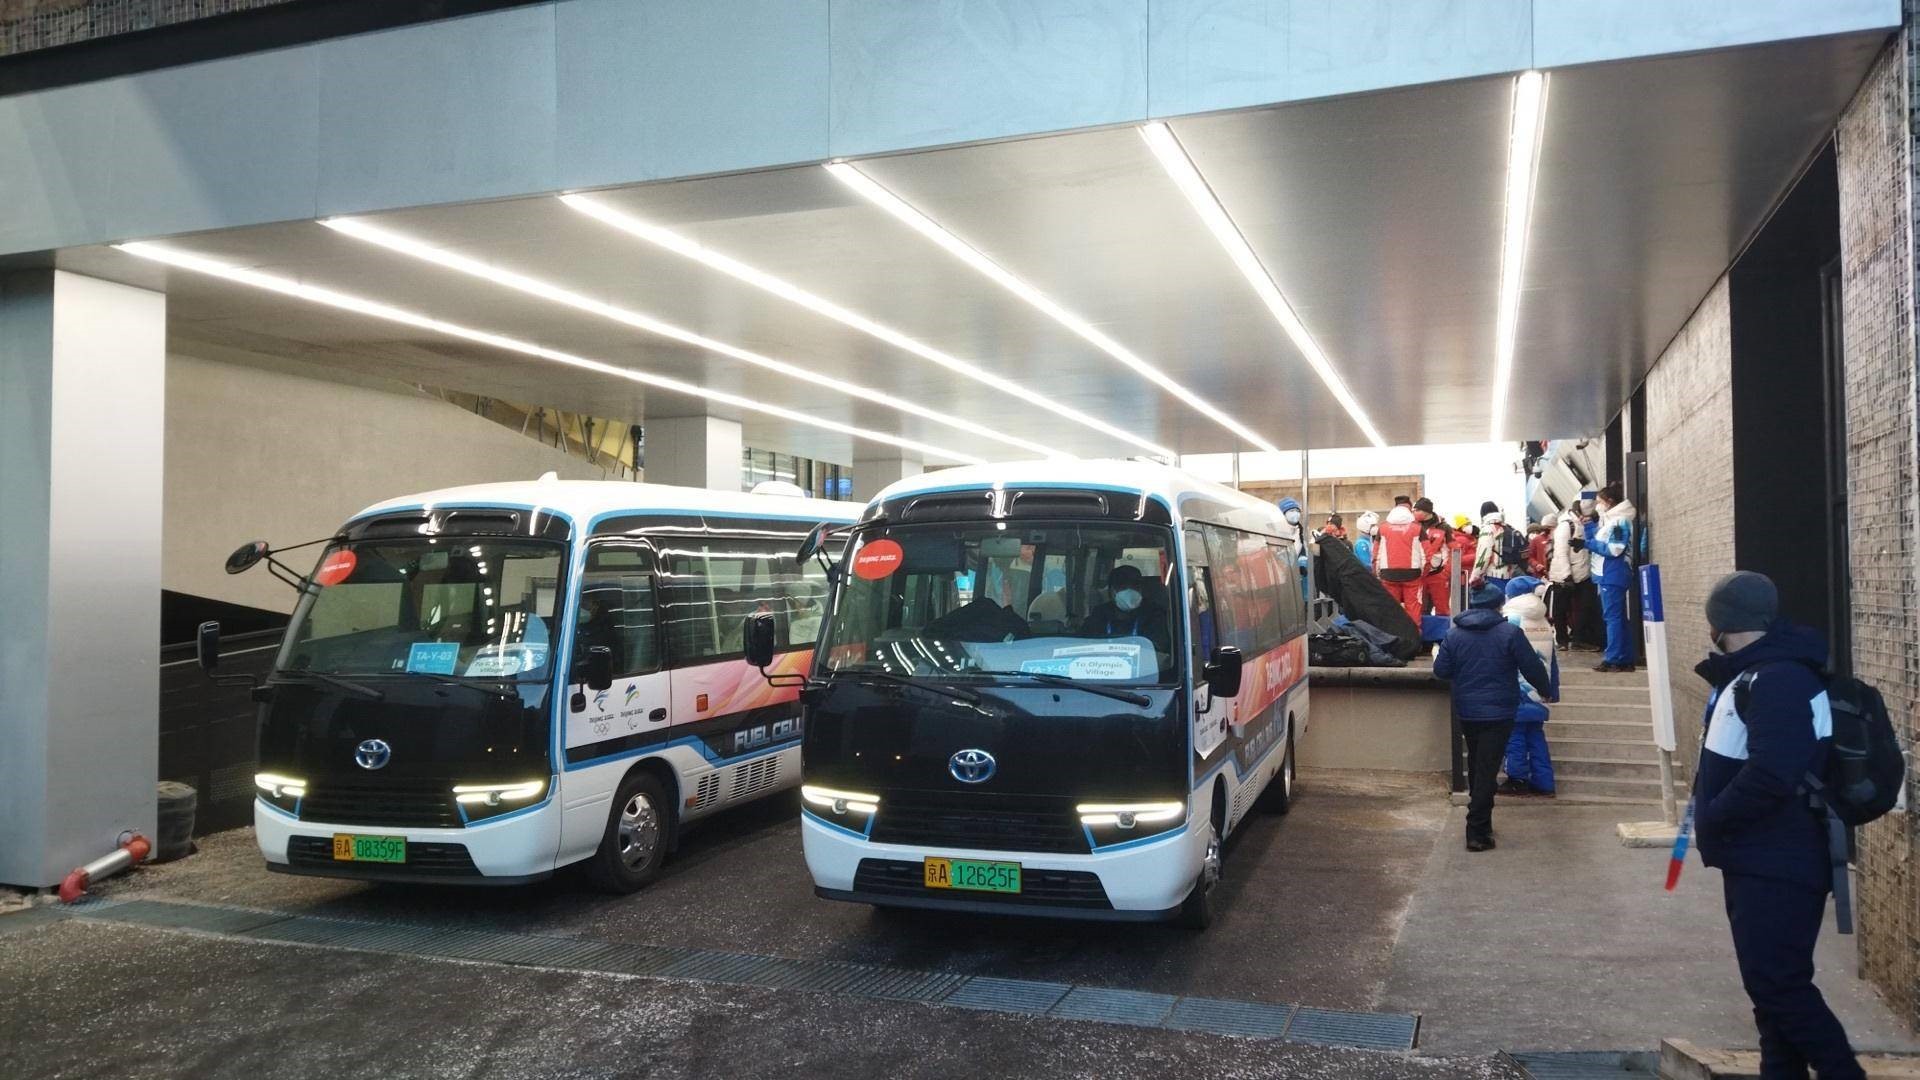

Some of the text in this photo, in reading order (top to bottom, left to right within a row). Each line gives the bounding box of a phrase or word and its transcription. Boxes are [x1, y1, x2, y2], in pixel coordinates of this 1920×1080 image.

[415, 651, 452, 661] TA-Y-03
[1085, 668, 1115, 676] Village
[1088, 661, 1123, 669] Olympic
[734, 717, 803, 752] FUEL CELL
[356, 839, 403, 859] 08359F
[927, 863, 1018, 889] 京A 12625F
